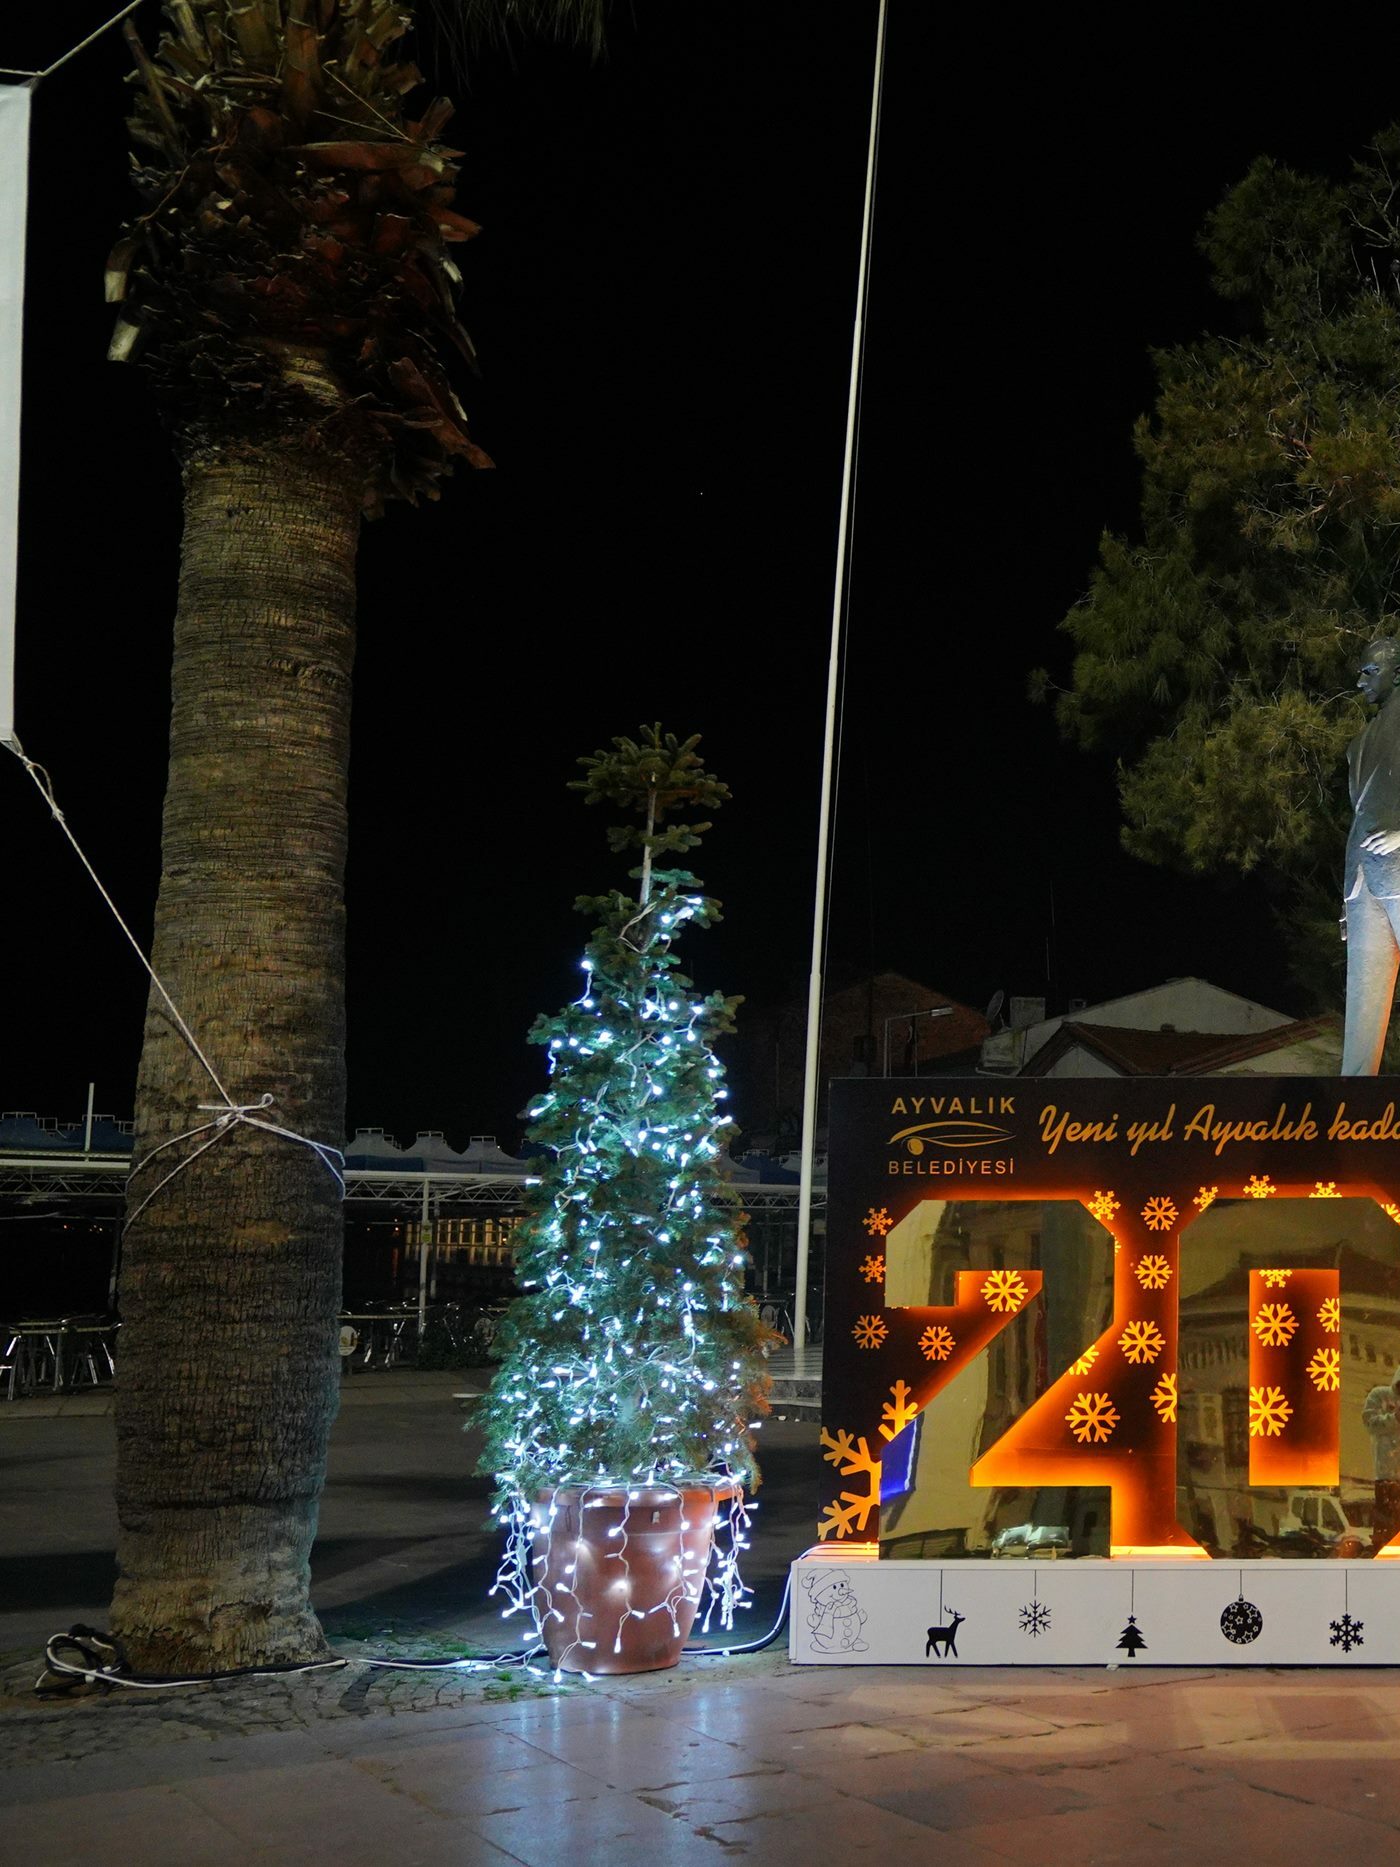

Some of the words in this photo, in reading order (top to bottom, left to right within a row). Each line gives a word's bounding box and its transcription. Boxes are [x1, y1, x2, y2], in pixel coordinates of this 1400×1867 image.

[891, 1096, 1017, 1115] AYVALIK
[1038, 1104, 1119, 1155] Yeni
[1126, 1103, 1177, 1157] yıl
[1184, 1102, 1319, 1157] Ayvalık
[888, 1157, 1015, 1175] BELEDİYESİ
